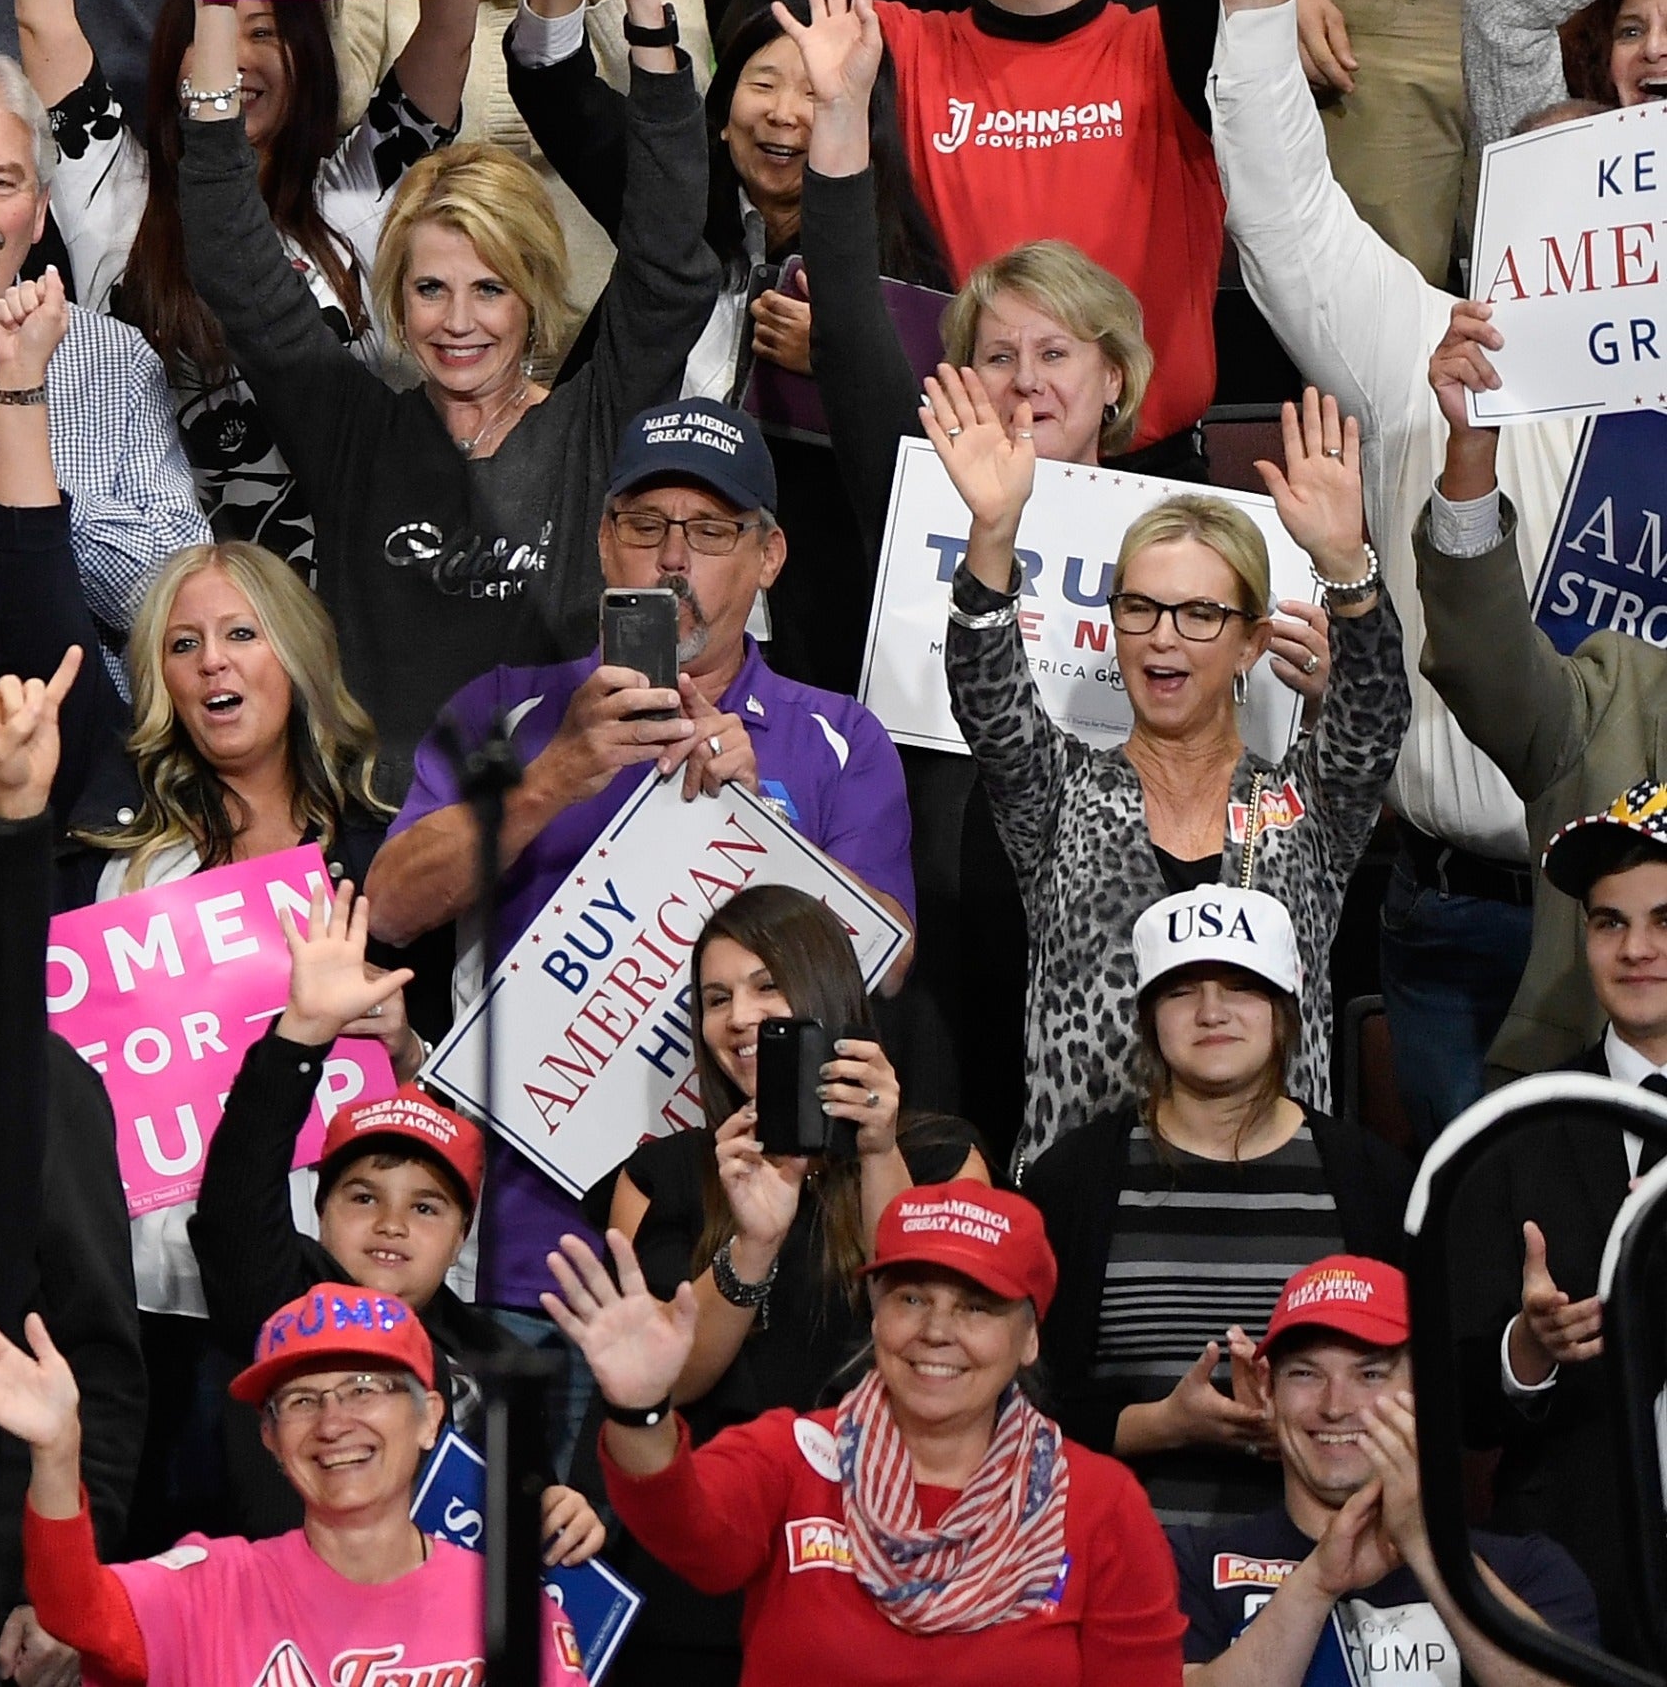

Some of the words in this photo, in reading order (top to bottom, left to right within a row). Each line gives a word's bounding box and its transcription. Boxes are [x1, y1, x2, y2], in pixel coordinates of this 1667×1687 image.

[977, 99, 1122, 134] JOHNSON
[975, 128, 1078, 149] GOVERNOR
[1081, 123, 1124, 141] 2018
[642, 414, 681, 432] MAKE
[683, 412, 744, 444] AMERICA
[647, 428, 692, 444] GREAT
[694, 429, 737, 455] AGAIN
[540, 878, 638, 997] BUY
[1167, 901, 1258, 945] USA
[521, 812, 769, 1136] AMERICAN
[351, 1100, 392, 1123] MAKE
[392, 1099, 459, 1136] AMERICA
[355, 1112, 403, 1131] GREAT
[403, 1116, 450, 1144] AGAIN
[898, 1202, 941, 1219] MAKE
[941, 1199, 1011, 1233] AMERICA
[902, 1216, 949, 1233] GREAT
[949, 1216, 1001, 1245] AGAIN
[1317, 1280, 1374, 1296] AMERICA
[1325, 1289, 1368, 1303] AGAIN
